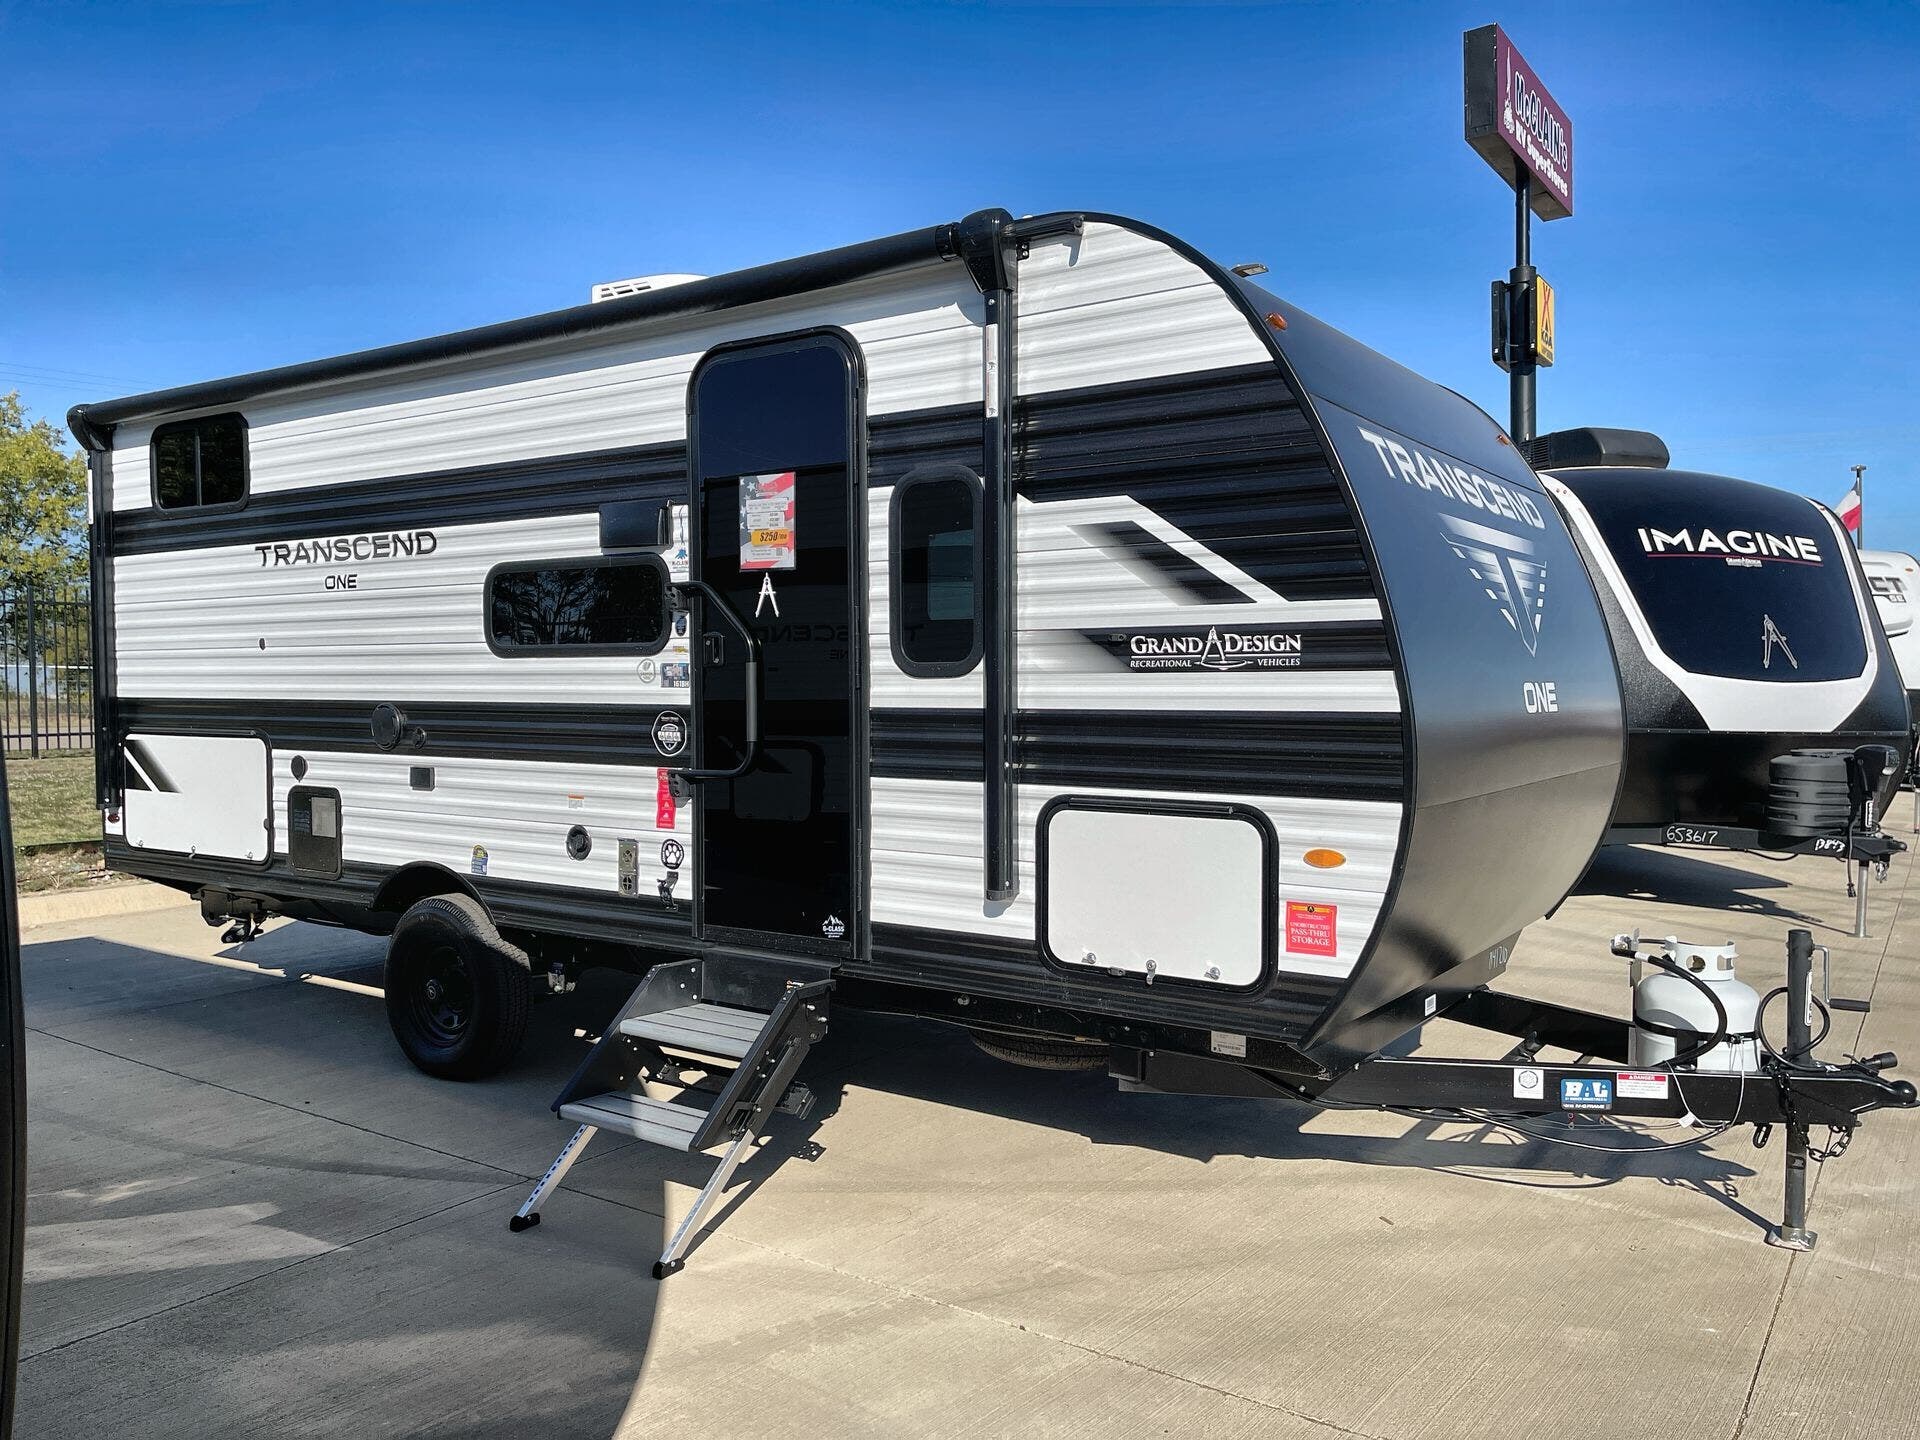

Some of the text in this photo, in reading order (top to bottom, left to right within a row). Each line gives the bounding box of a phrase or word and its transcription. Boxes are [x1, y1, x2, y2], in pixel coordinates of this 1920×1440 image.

[1515, 119, 1527, 148] RV
[1357, 425, 1546, 529] TRANSCEND
[255, 530, 437, 567] TRANSCEND
[1637, 527, 1822, 562] IMAGINE
[324, 574, 358, 590] ONE
[1130, 633, 1302, 654] GRAND DESIGN
[1130, 658, 1301, 668] RECREATIONAL VEHICLES
[1523, 682, 1559, 713] ONE
[1666, 825, 1719, 844] 653617
[1291, 936, 1330, 946] STORAGE
